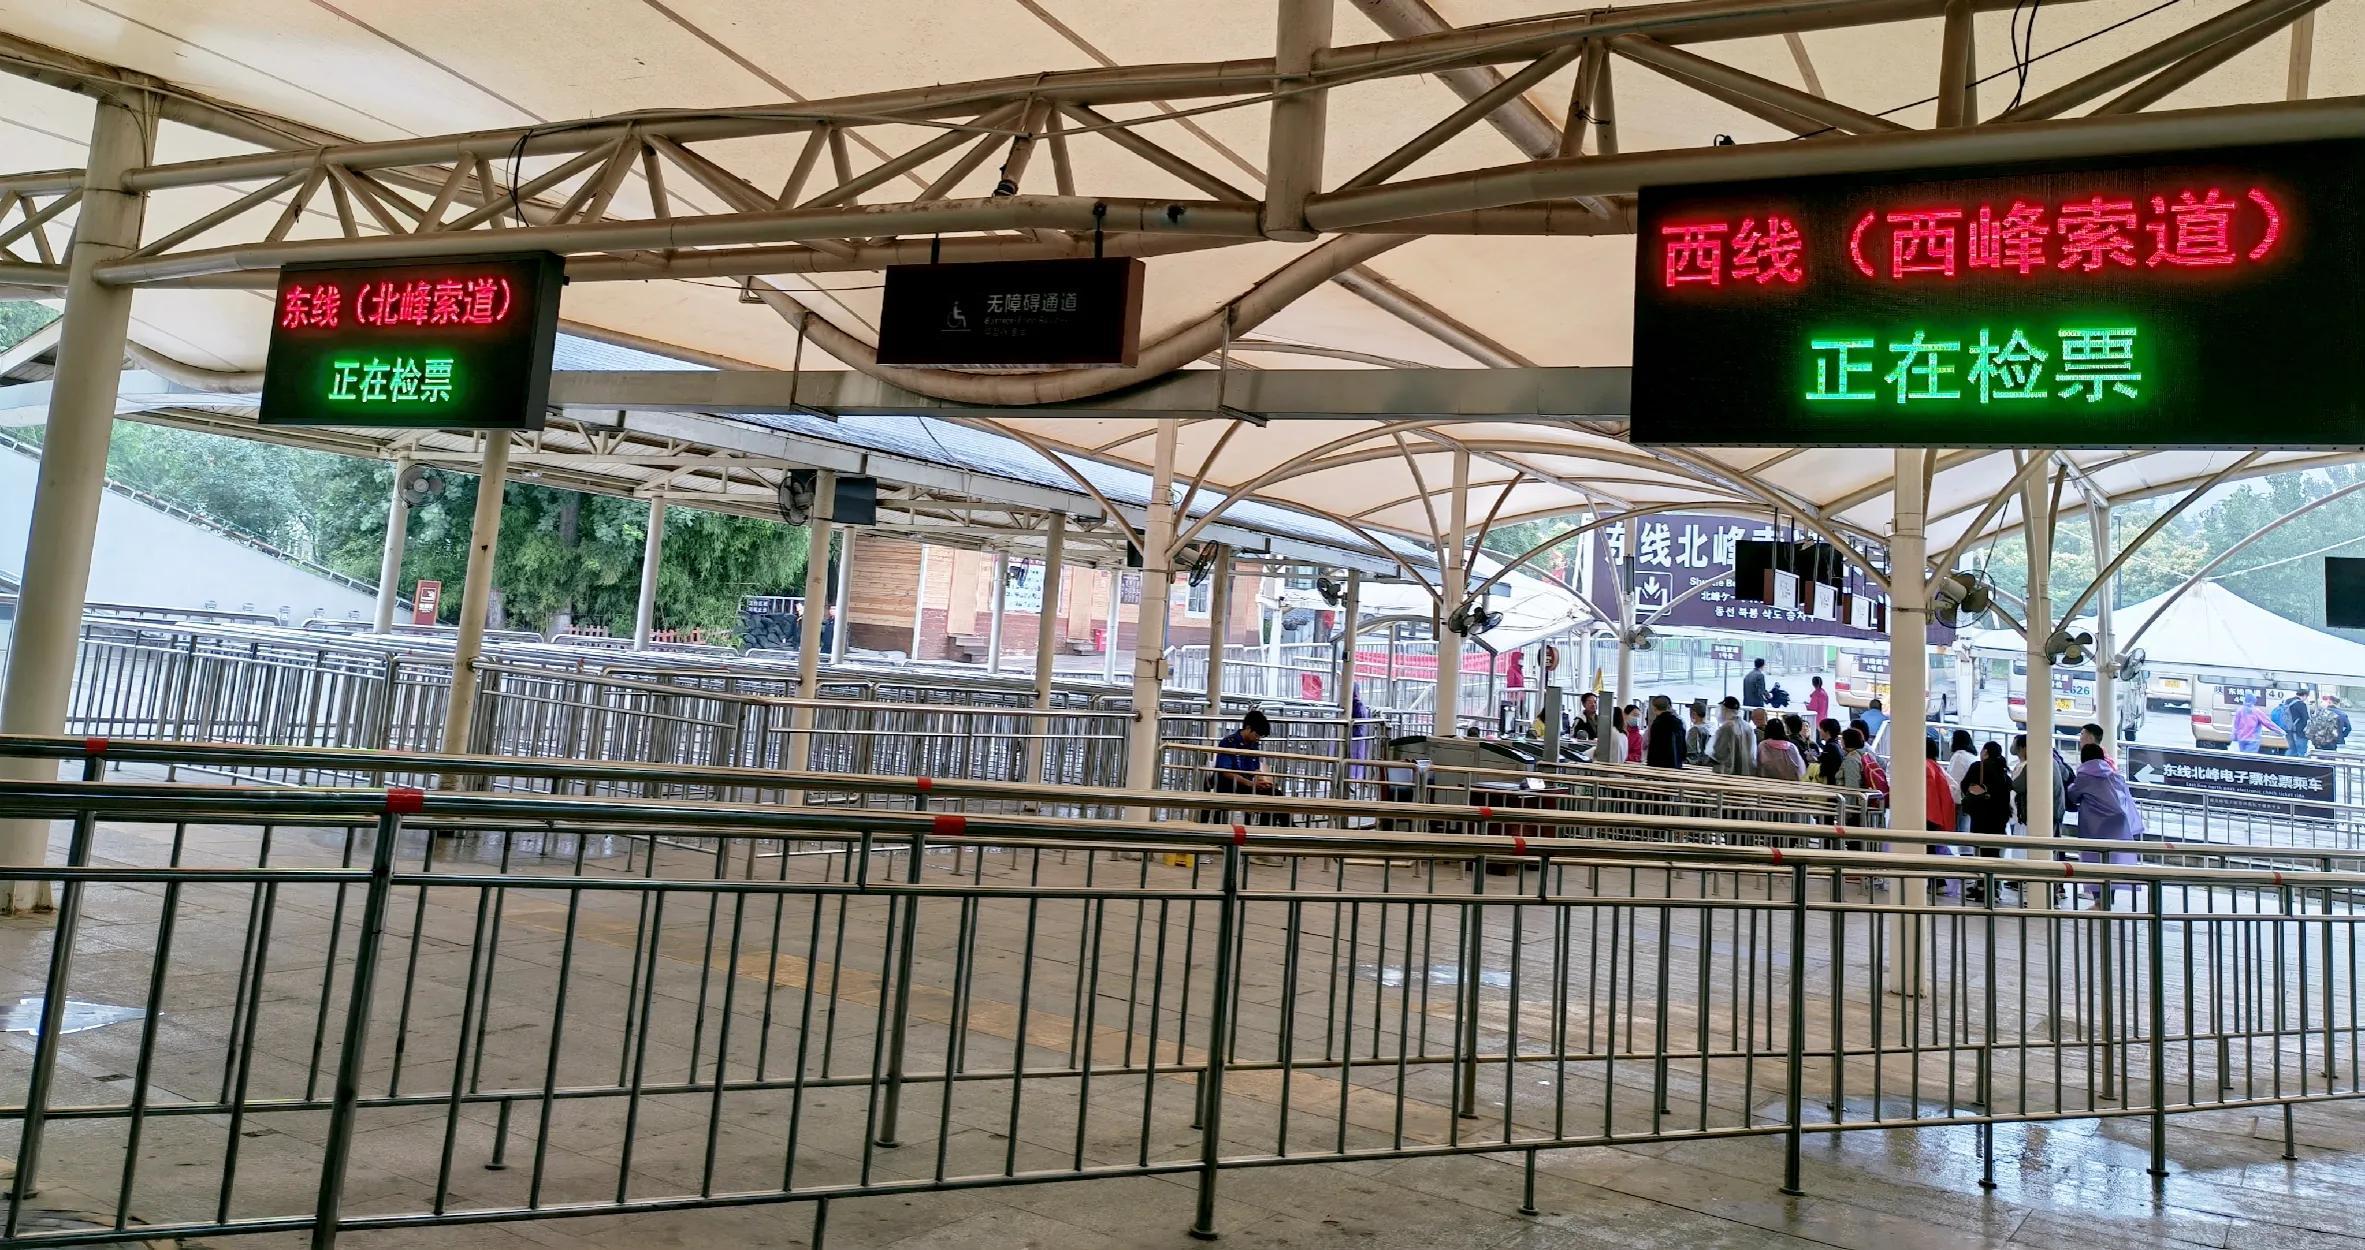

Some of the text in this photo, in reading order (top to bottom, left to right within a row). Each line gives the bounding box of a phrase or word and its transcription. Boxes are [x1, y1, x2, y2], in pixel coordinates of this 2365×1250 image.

[1662, 188, 2284, 288] 西线（西峰索道）
[282, 277, 511, 329] 东线（北峰索道）
[986, 292, 1078, 314] 无障碍通道
[328, 356, 455, 404] 正在检票
[1805, 326, 2143, 405] 正在检票
[2063, 685, 2090, 696] 626
[2162, 763, 2324, 792] 东线北峰电子票检票乘车
